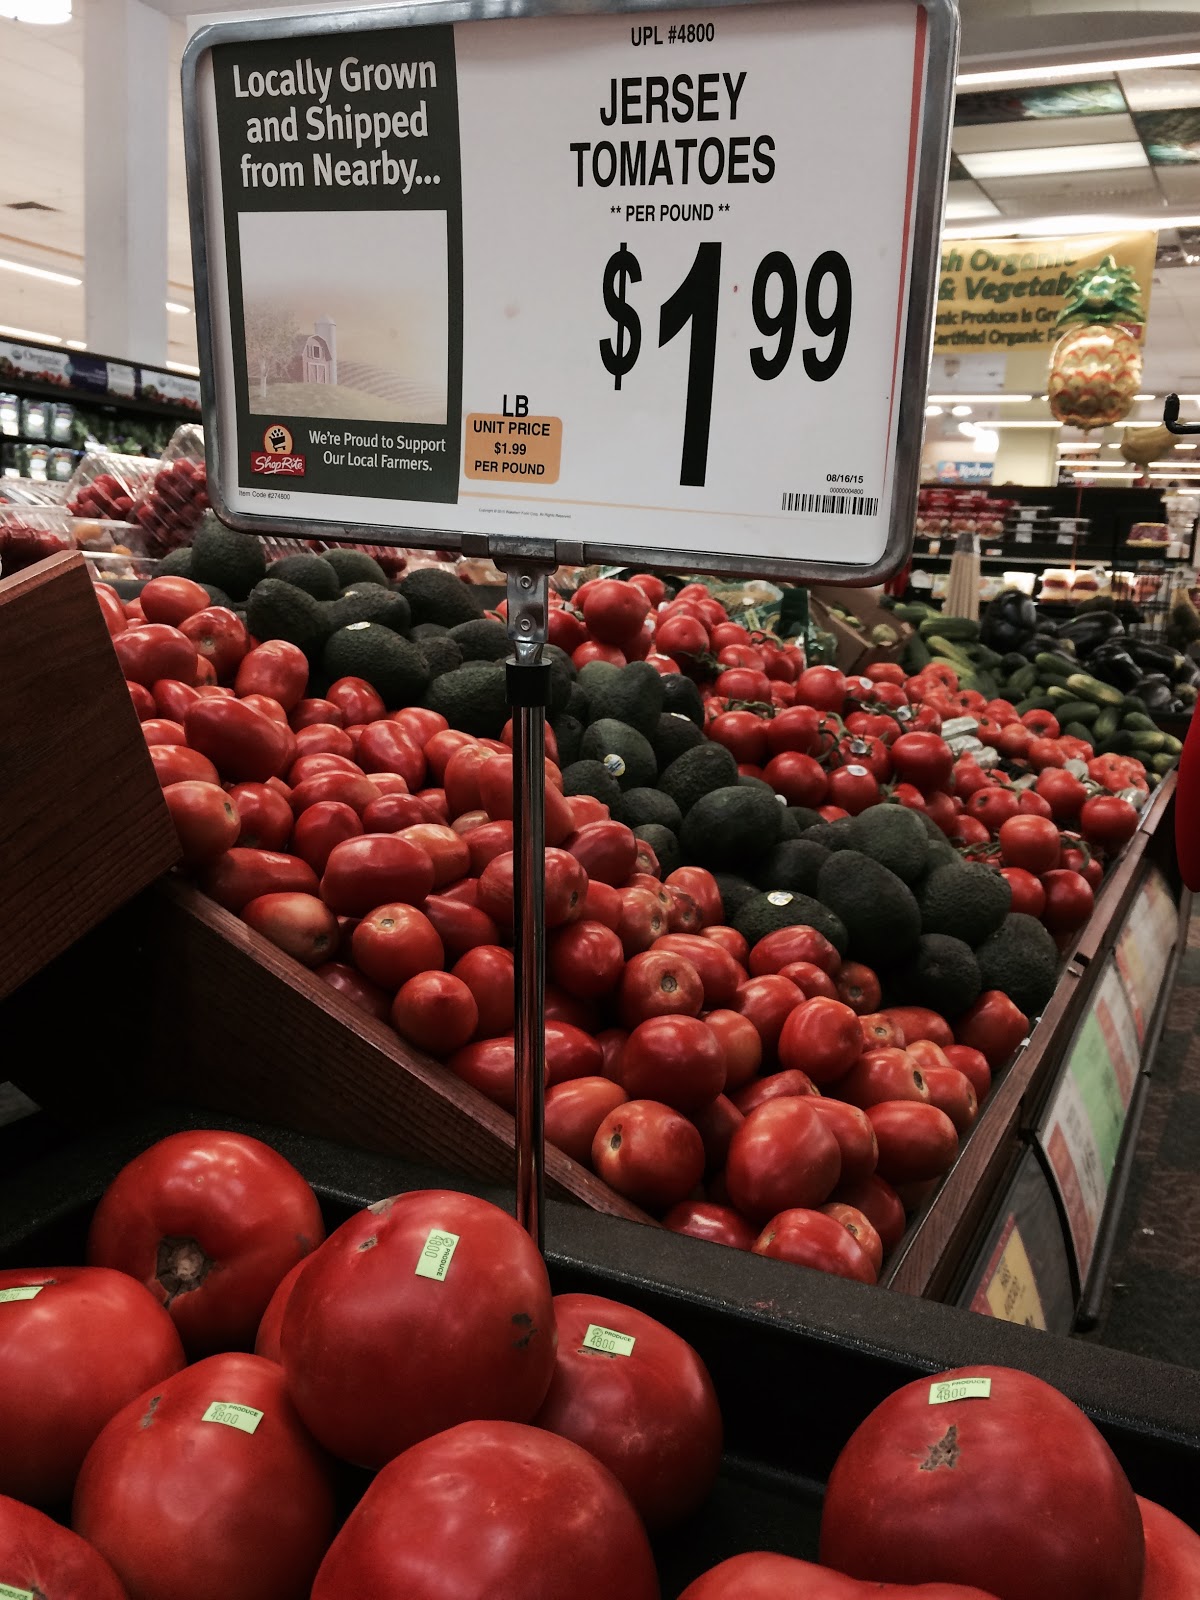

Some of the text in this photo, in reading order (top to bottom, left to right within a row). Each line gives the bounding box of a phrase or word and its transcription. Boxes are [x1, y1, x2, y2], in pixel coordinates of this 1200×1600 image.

[631, 22, 715, 46] UPL #4800
[232, 56, 437, 104] Locally Grown
[599, 71, 747, 127] JERSEY
[246, 100, 429, 149] and Shipped
[569, 134, 776, 188] TOMATOES
[240, 150, 441, 195] from Nearby...
[625, 205, 656, 222] PER
[659, 204, 714, 222] POUND
[965, 271, 1076, 304] Vegetab
[961, 309, 1019, 325] Produce
[935, 329, 986, 346] ertified
[988, 329, 1044, 347] Organic
[502, 394, 529, 418] LB
[473, 419, 551, 436] UNIT PRICE
[308, 430, 446, 454] We're Proud to Support
[494, 441, 527, 456] $1.99
[254, 455, 303, 475] ShopRite
[323, 450, 433, 472] Our Local Farmers.
[474, 460, 545, 475] PER POUND
[826, 473, 864, 484] 08/16/15
[238, 490, 251, 498] Item
[251, 490, 267, 498] Code
[425, 1235, 443, 1259] 4800
[436, 1248, 451, 1277] PRODUCE
[590, 1335, 616, 1351] 4800
[604, 1330, 632, 1342] PRODUCE
[937, 1387, 966, 1400] 4800
[210, 1410, 239, 1425] 4800
[228, 1404, 259, 1418] PRODUCE
